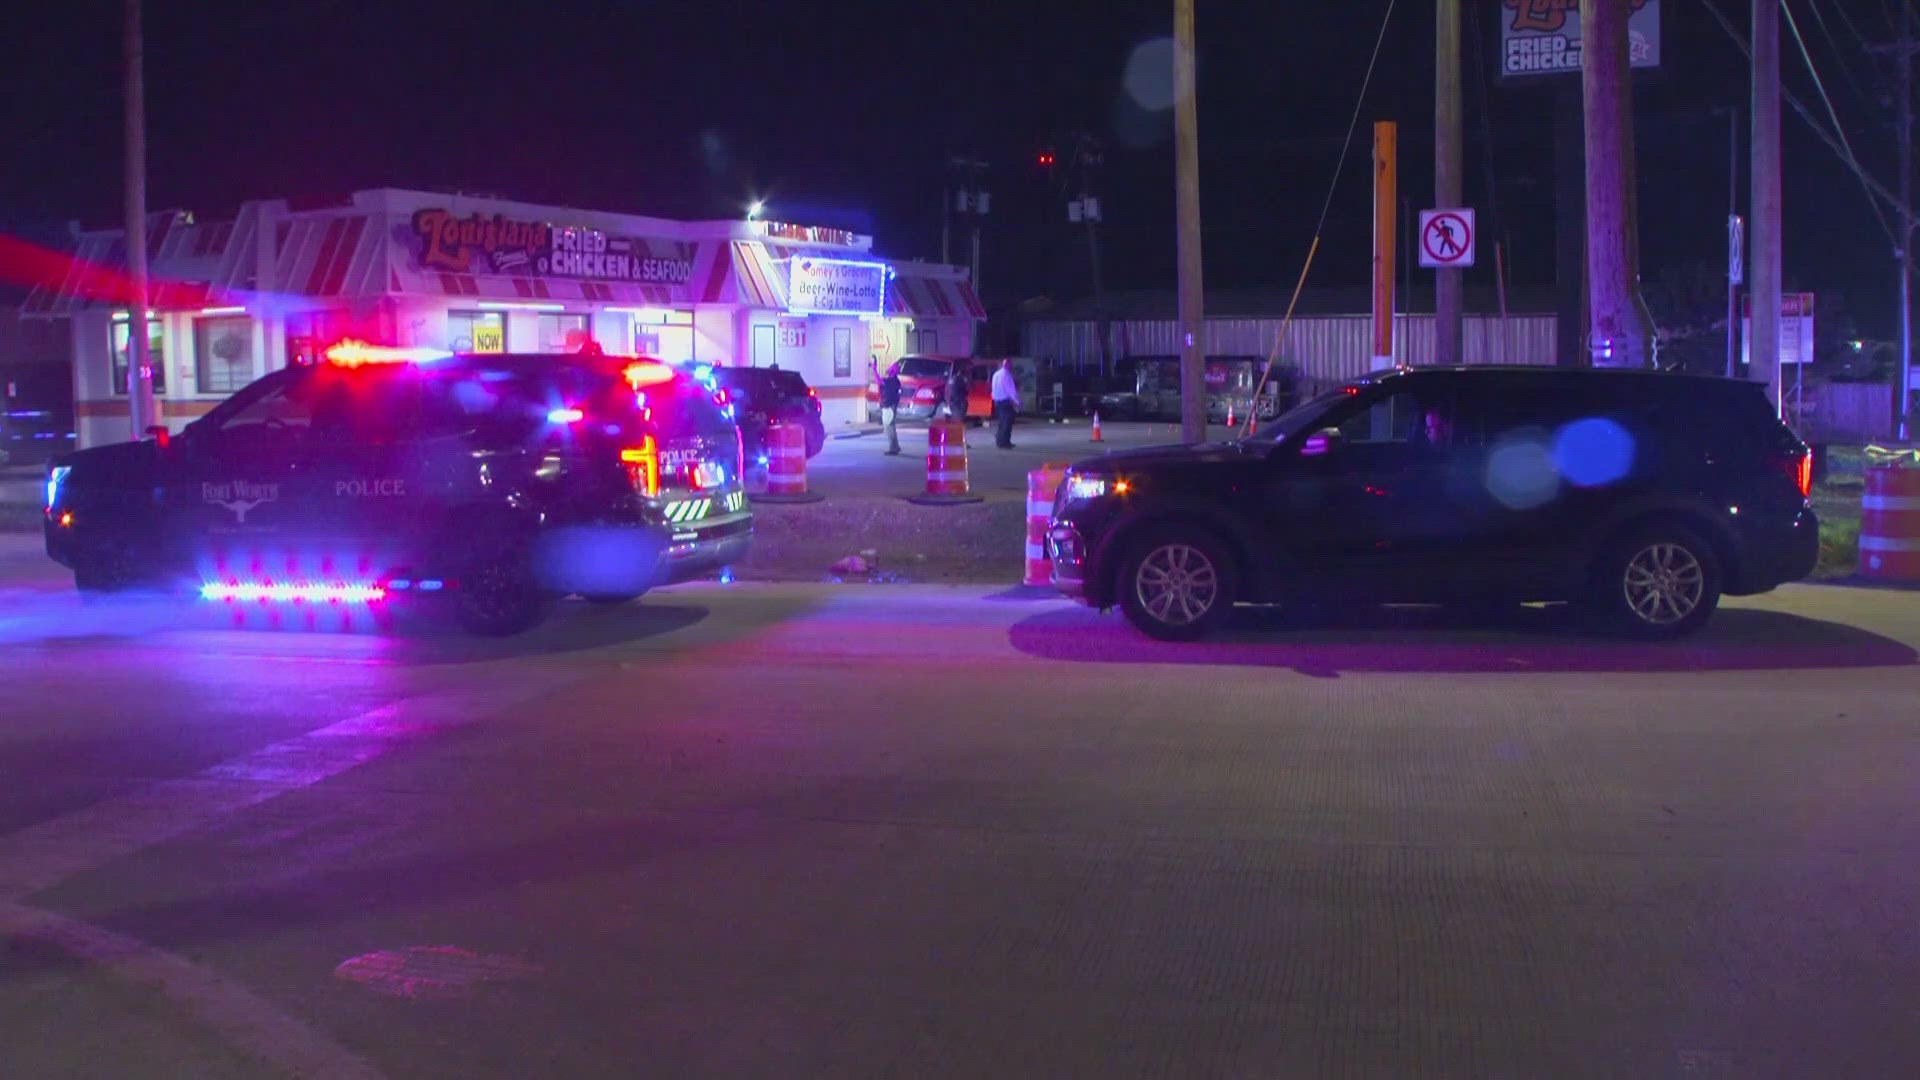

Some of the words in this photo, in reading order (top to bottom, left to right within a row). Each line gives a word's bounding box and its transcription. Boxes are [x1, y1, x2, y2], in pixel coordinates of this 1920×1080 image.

[1508, 36, 1567, 54] FRIED
[1507, 52, 1583, 71] CHICKE
[415, 209, 548, 271] Louisiana
[552, 228, 606, 252] FRIED
[552, 251, 629, 278] CHICKEN
[632, 258, 641, 279] &
[643, 260, 690, 281] SEAFOOD
[800, 280, 877, 298] Beer-Wine-Lotto
[477, 333, 500, 350] NOW
[778, 327, 805, 347] EBT
[660, 449, 698, 463] POLICE
[336, 479, 405, 496] POLICE
